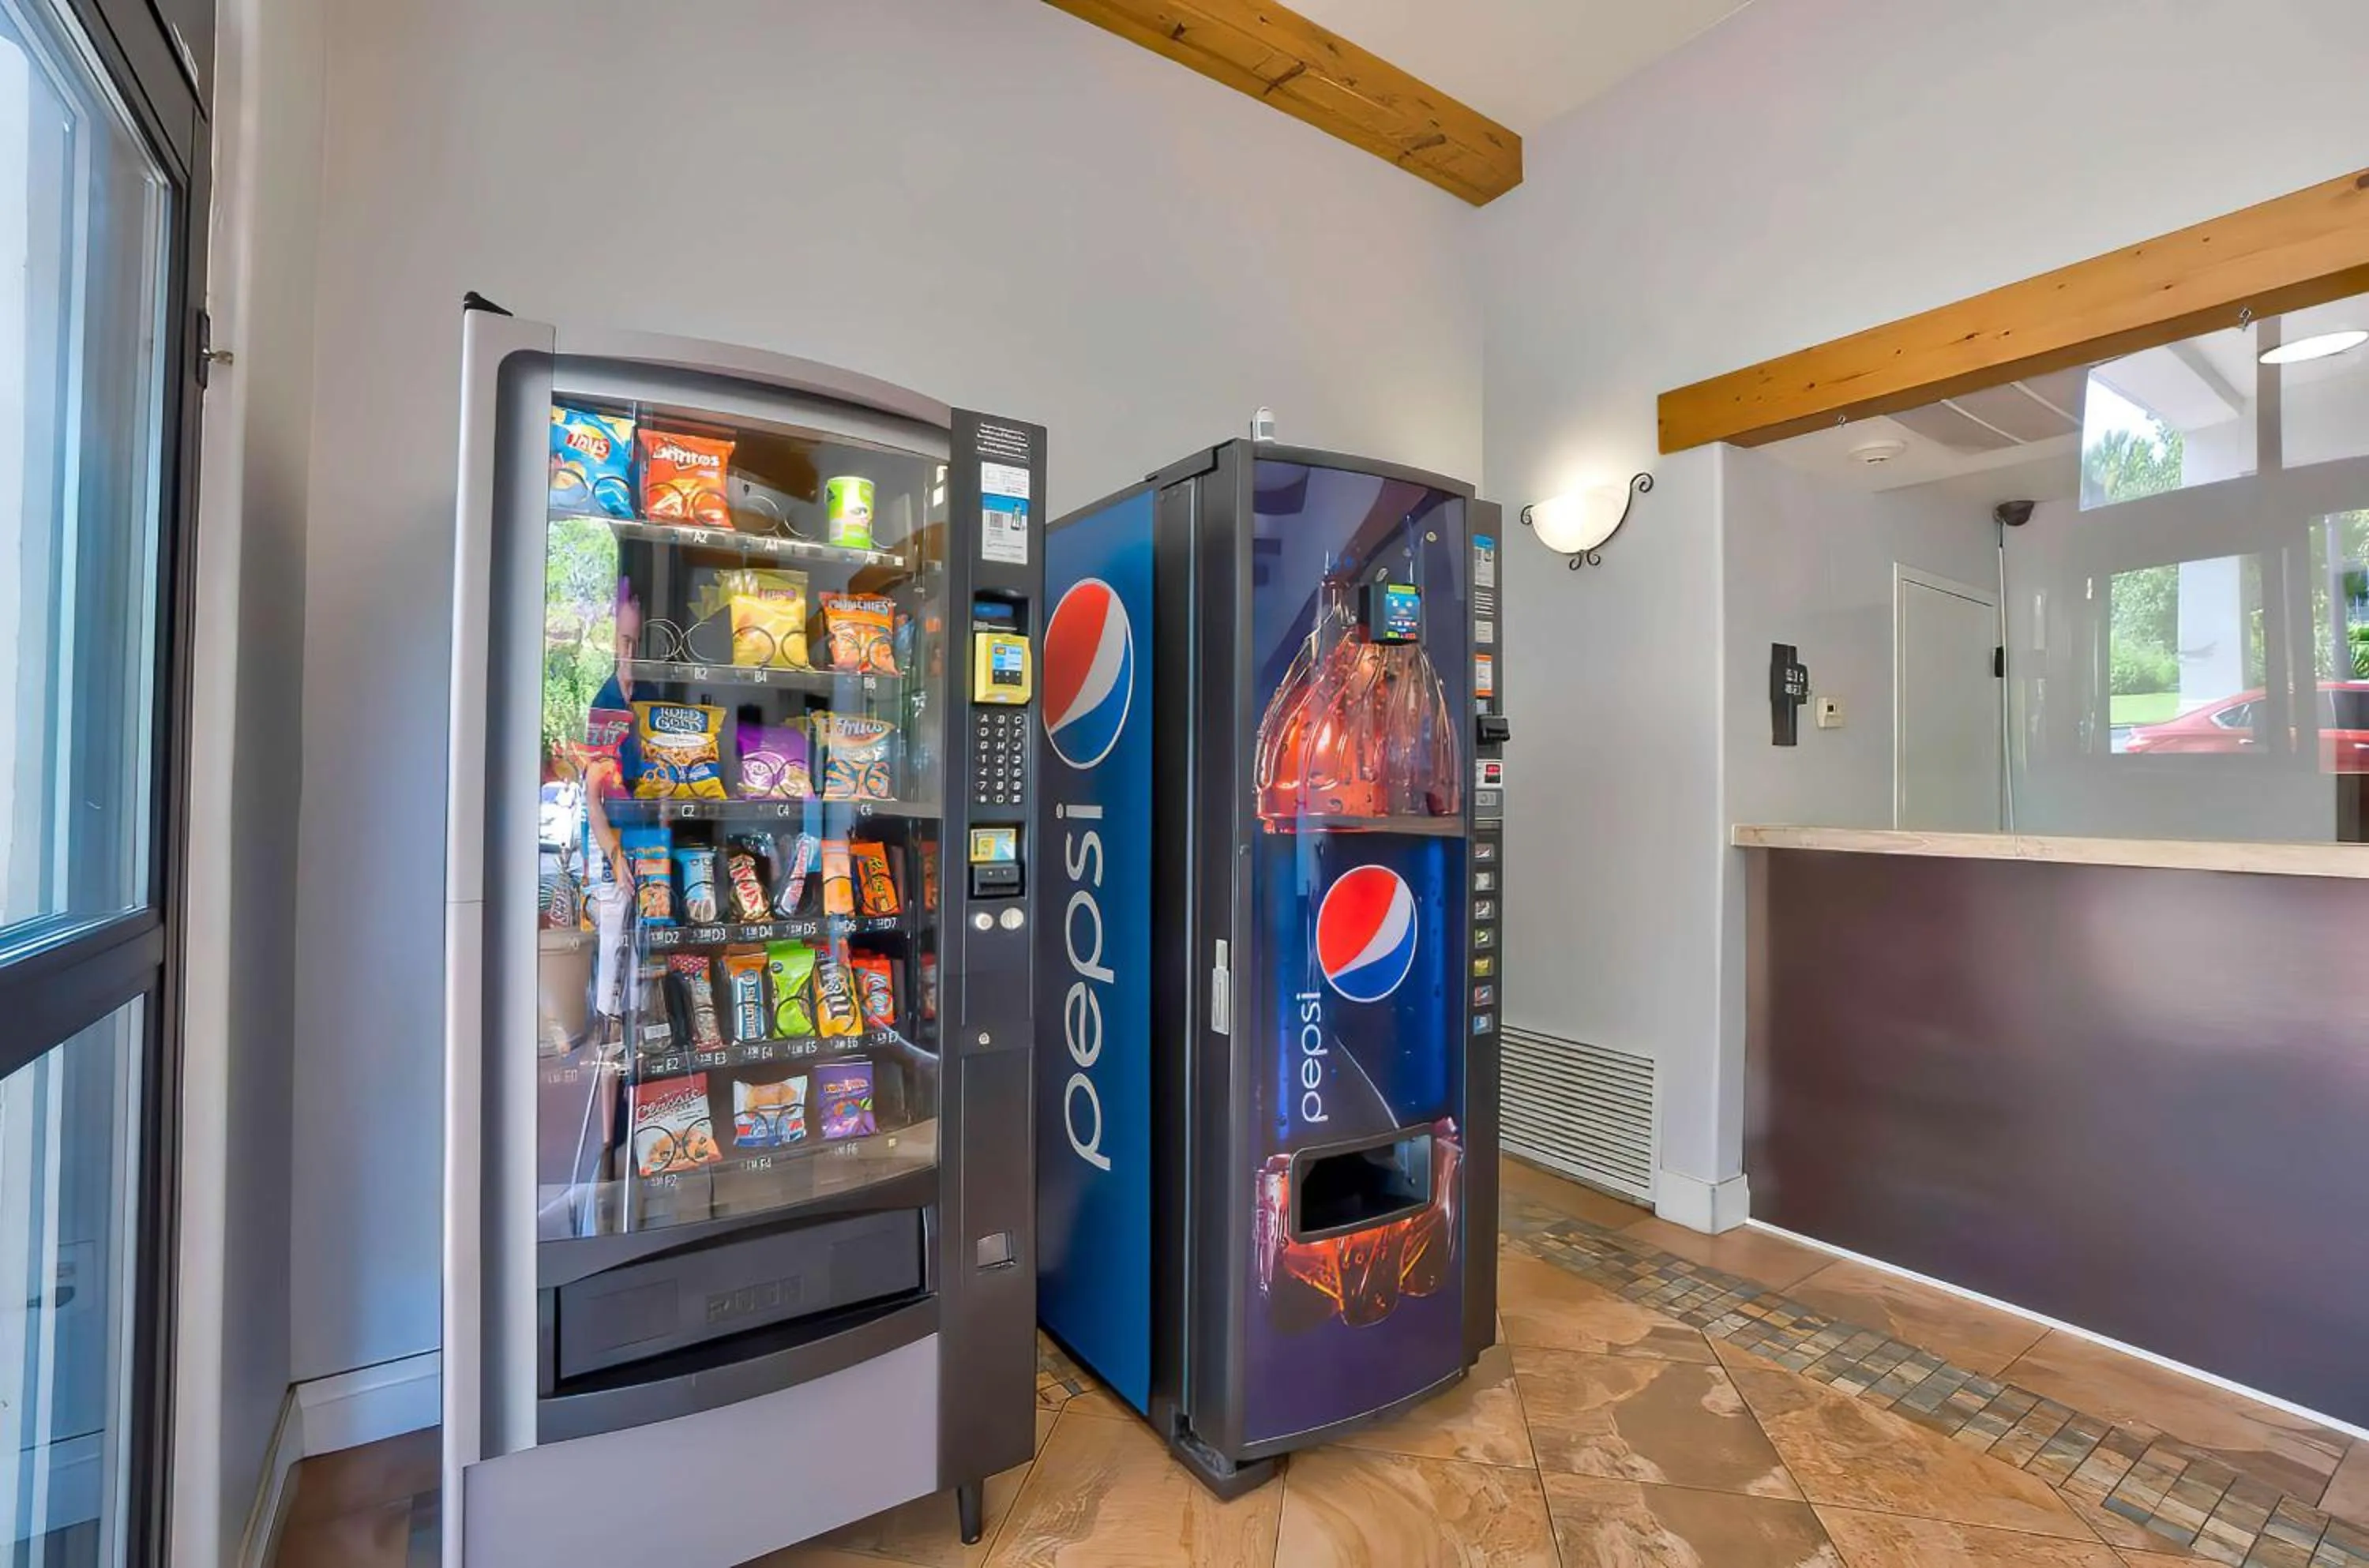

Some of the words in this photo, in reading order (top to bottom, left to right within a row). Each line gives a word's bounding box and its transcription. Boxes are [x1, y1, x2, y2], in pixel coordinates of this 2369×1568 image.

[777, 805, 789, 816] C4
[844, 920, 856, 932] D6
[884, 917, 897, 929] D7
[712, 928, 726, 940] D3
[759, 926, 772, 937] D4
[804, 923, 816, 936] D5
[665, 932, 679, 943] D2
[1056, 803, 1114, 1171] pepsi
[1296, 992, 1328, 1123] pepsi
[666, 1058, 678, 1070] E2
